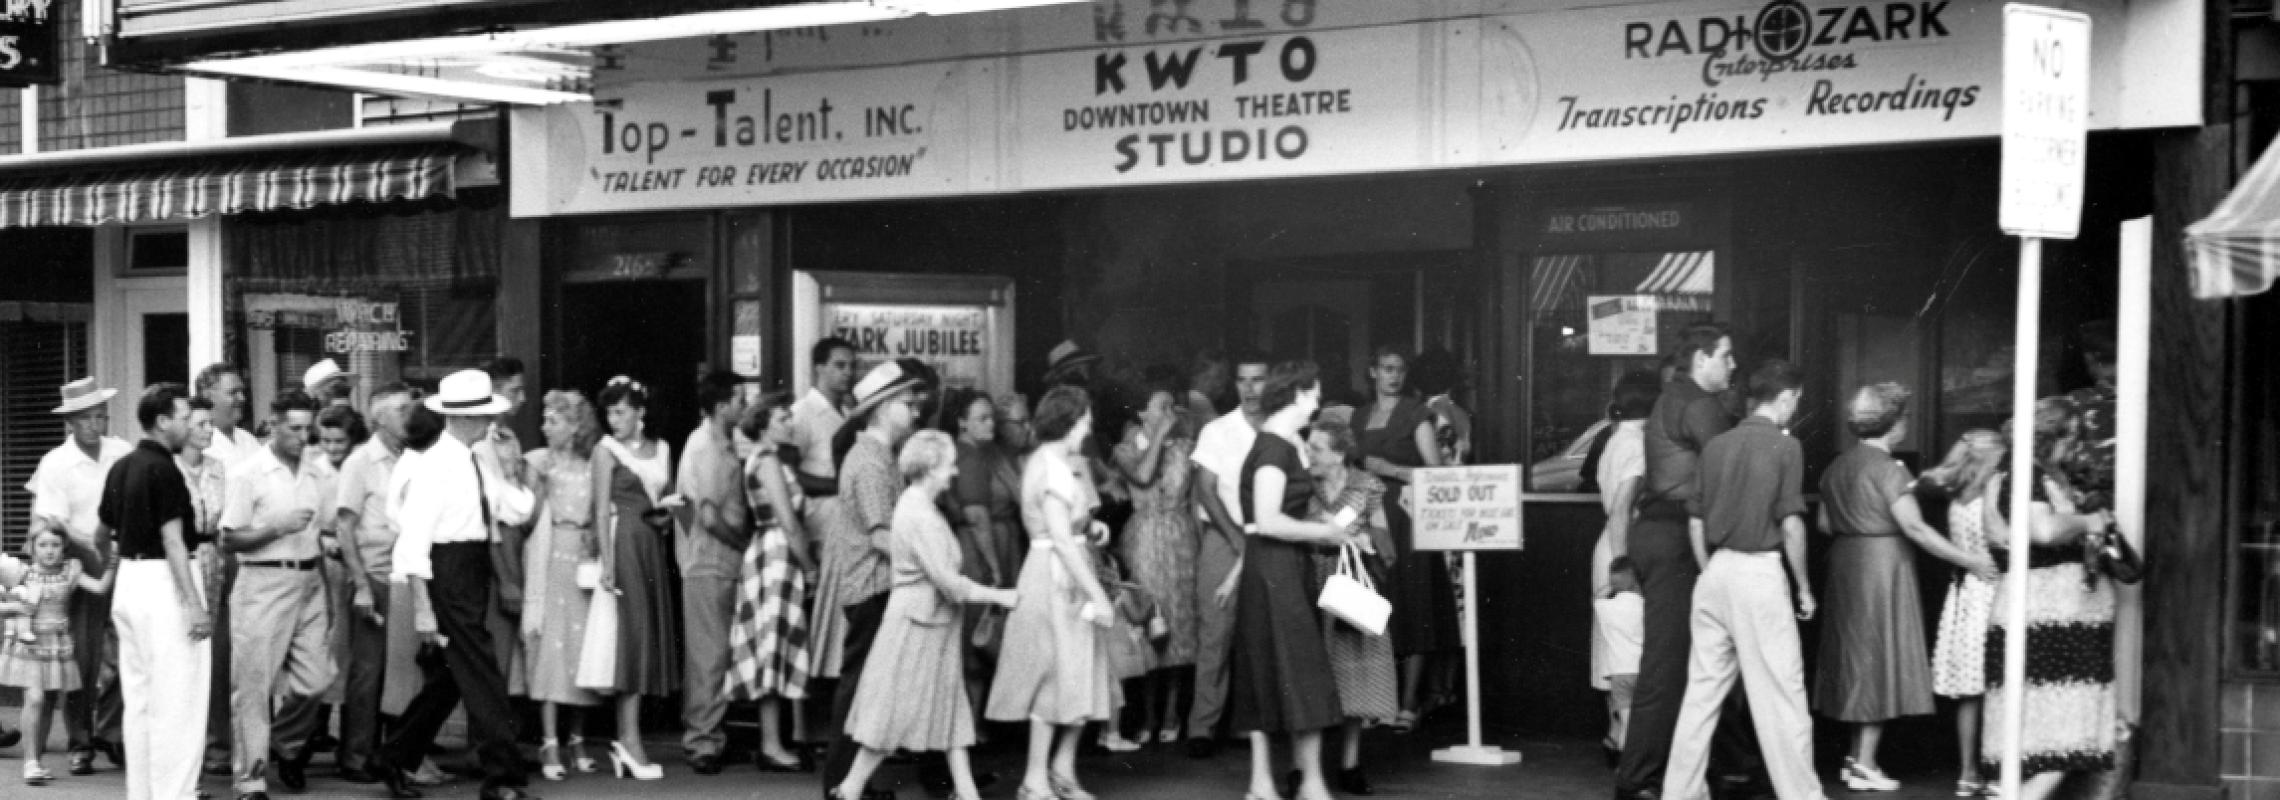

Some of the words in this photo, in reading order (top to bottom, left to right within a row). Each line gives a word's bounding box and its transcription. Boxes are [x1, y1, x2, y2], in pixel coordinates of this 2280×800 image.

[1094, 36, 1318, 96] KWTO
[2032, 37, 2064, 80] NO
[1063, 99, 1210, 131] DOWNTOWN
[1235, 88, 1352, 120] THEATRE
[1558, 93, 1769, 134] Transcriptions
[1806, 73, 1982, 121] Recordings
[594, 98, 670, 166] Top
[865, 103, 923, 138] INC.
[1114, 124, 1309, 173] STUDIO
[696, 165, 737, 188] FOR
[746, 161, 809, 185] EVERY
[1548, 214, 1575, 233] AIR
[1577, 210, 1681, 232] CONDITIONED
[897, 327, 981, 356] JUBILEE
[1427, 485, 1462, 504] SOLD
[1467, 483, 1497, 502] OUT
